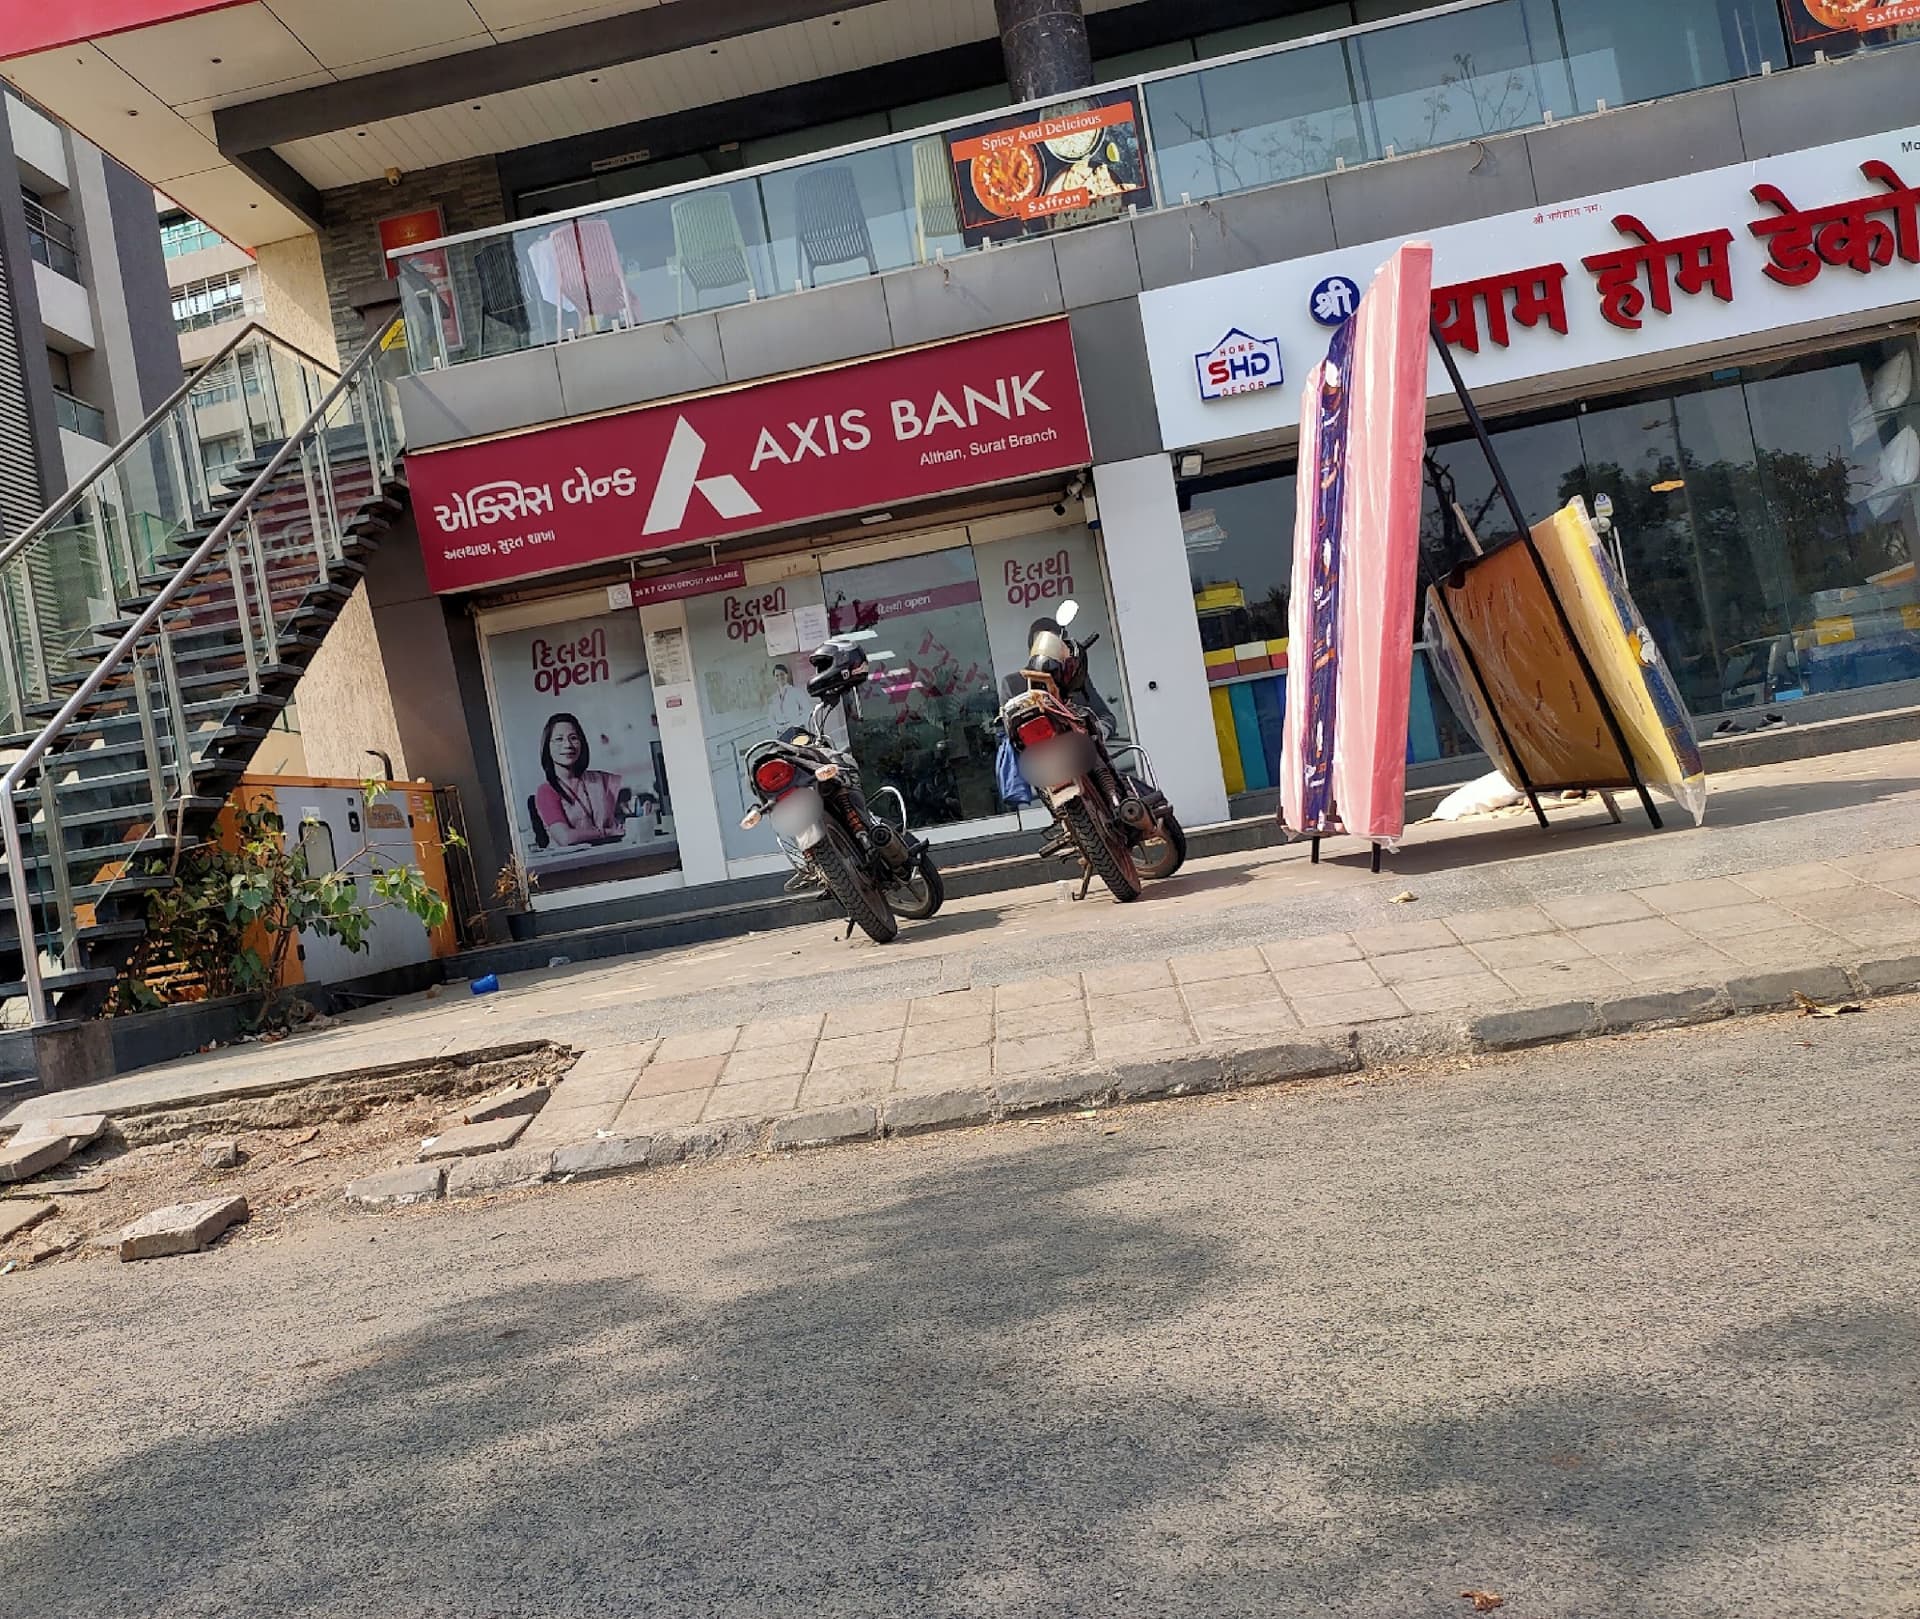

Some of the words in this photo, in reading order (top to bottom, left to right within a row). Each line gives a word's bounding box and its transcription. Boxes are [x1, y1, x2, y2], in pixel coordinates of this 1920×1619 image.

[982, 134, 1014, 151] Spicy
[1018, 127, 1042, 143] And
[1045, 115, 1101, 135] Delicious
[1027, 194, 1081, 213] Saffron
[1314, 279, 1353, 320] श्री
[1430, 262, 1568, 354] याम
[1580, 213, 1734, 330] होम
[1746, 159, 1920, 287] डेको
[1219, 342, 1255, 356] HOME
[1208, 352, 1270, 386] SHD
[1222, 380, 1266, 396] DECOR
[750, 408, 872, 471] AXIS
[889, 370, 1052, 441] BANK
[919, 446, 967, 467] Althan,
[968, 437, 1006, 455] Surat
[1008, 427, 1058, 447] Branch
[433, 480, 554, 532] એક્સિસ
[561, 466, 637, 504] બેન્ક
[497, 536, 524, 555] સુરત
[527, 529, 556, 545] શાખા
[657, 583, 677, 592] CASH
[677, 577, 703, 589] DEPOSIT
[1004, 549, 1070, 586] દિલથી
[724, 586, 786, 622] દિલથી
[904, 596, 931, 609] open
[1007, 575, 1074, 608] open
[532, 628, 606, 670] દિલથી
[534, 658, 609, 696] open
